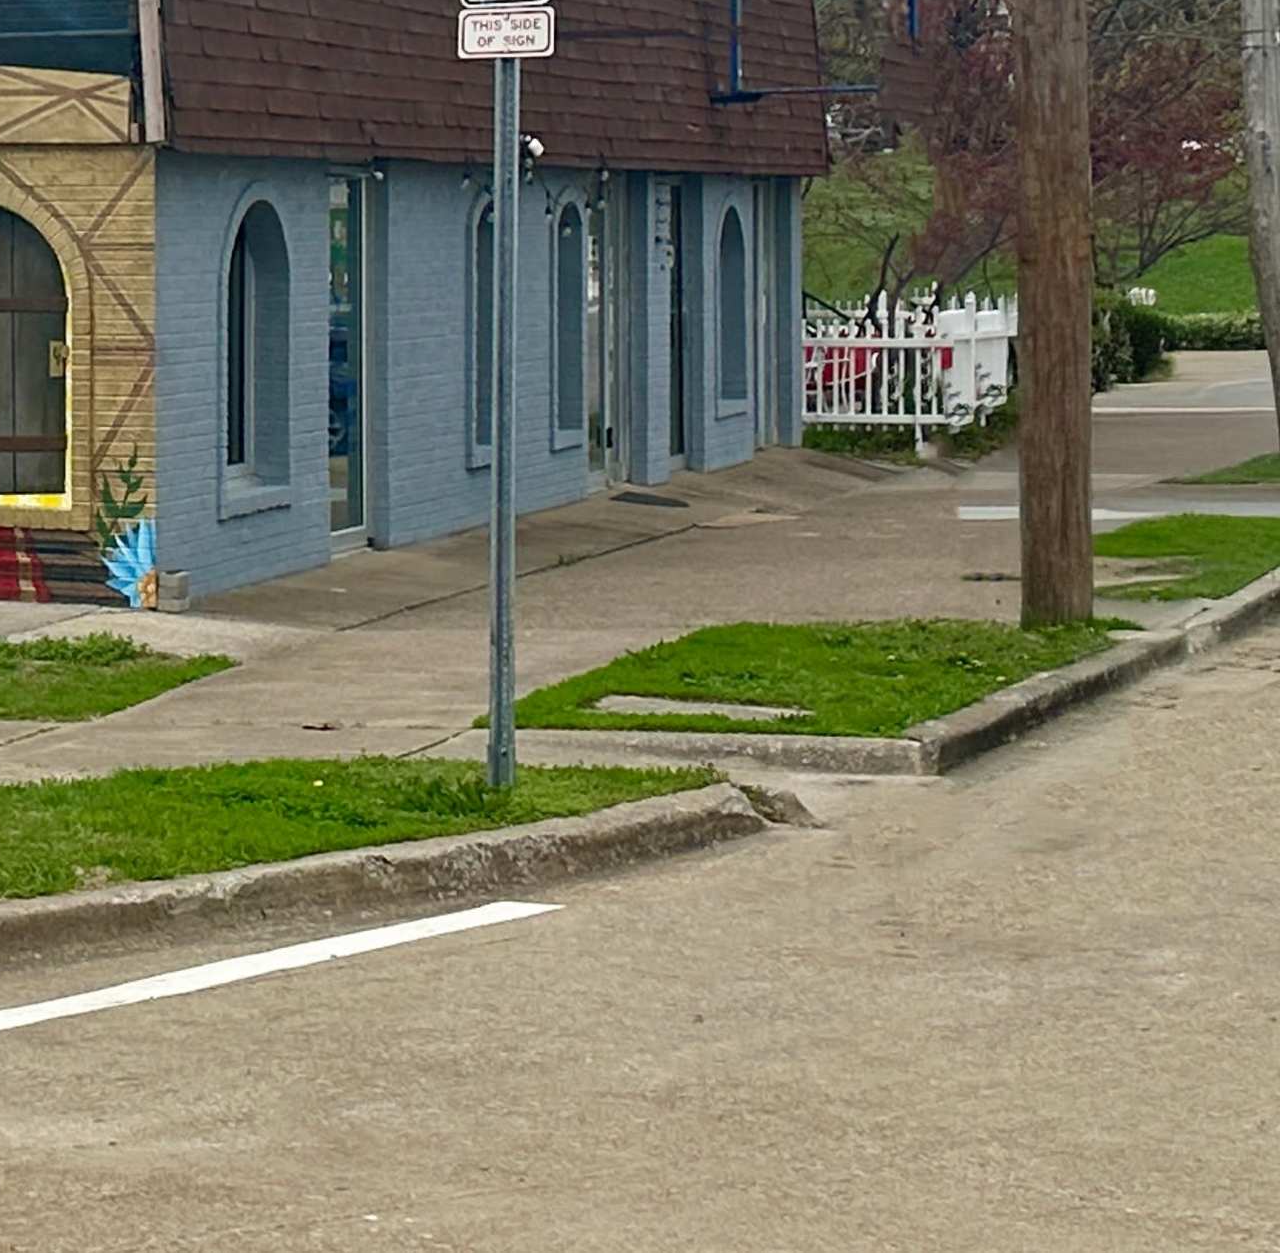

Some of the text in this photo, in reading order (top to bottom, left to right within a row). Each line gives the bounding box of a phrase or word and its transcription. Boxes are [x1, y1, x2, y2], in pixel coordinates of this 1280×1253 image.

[471, 18, 541, 32] THIS SIDE
[477, 34, 535, 48] OF SIGN
